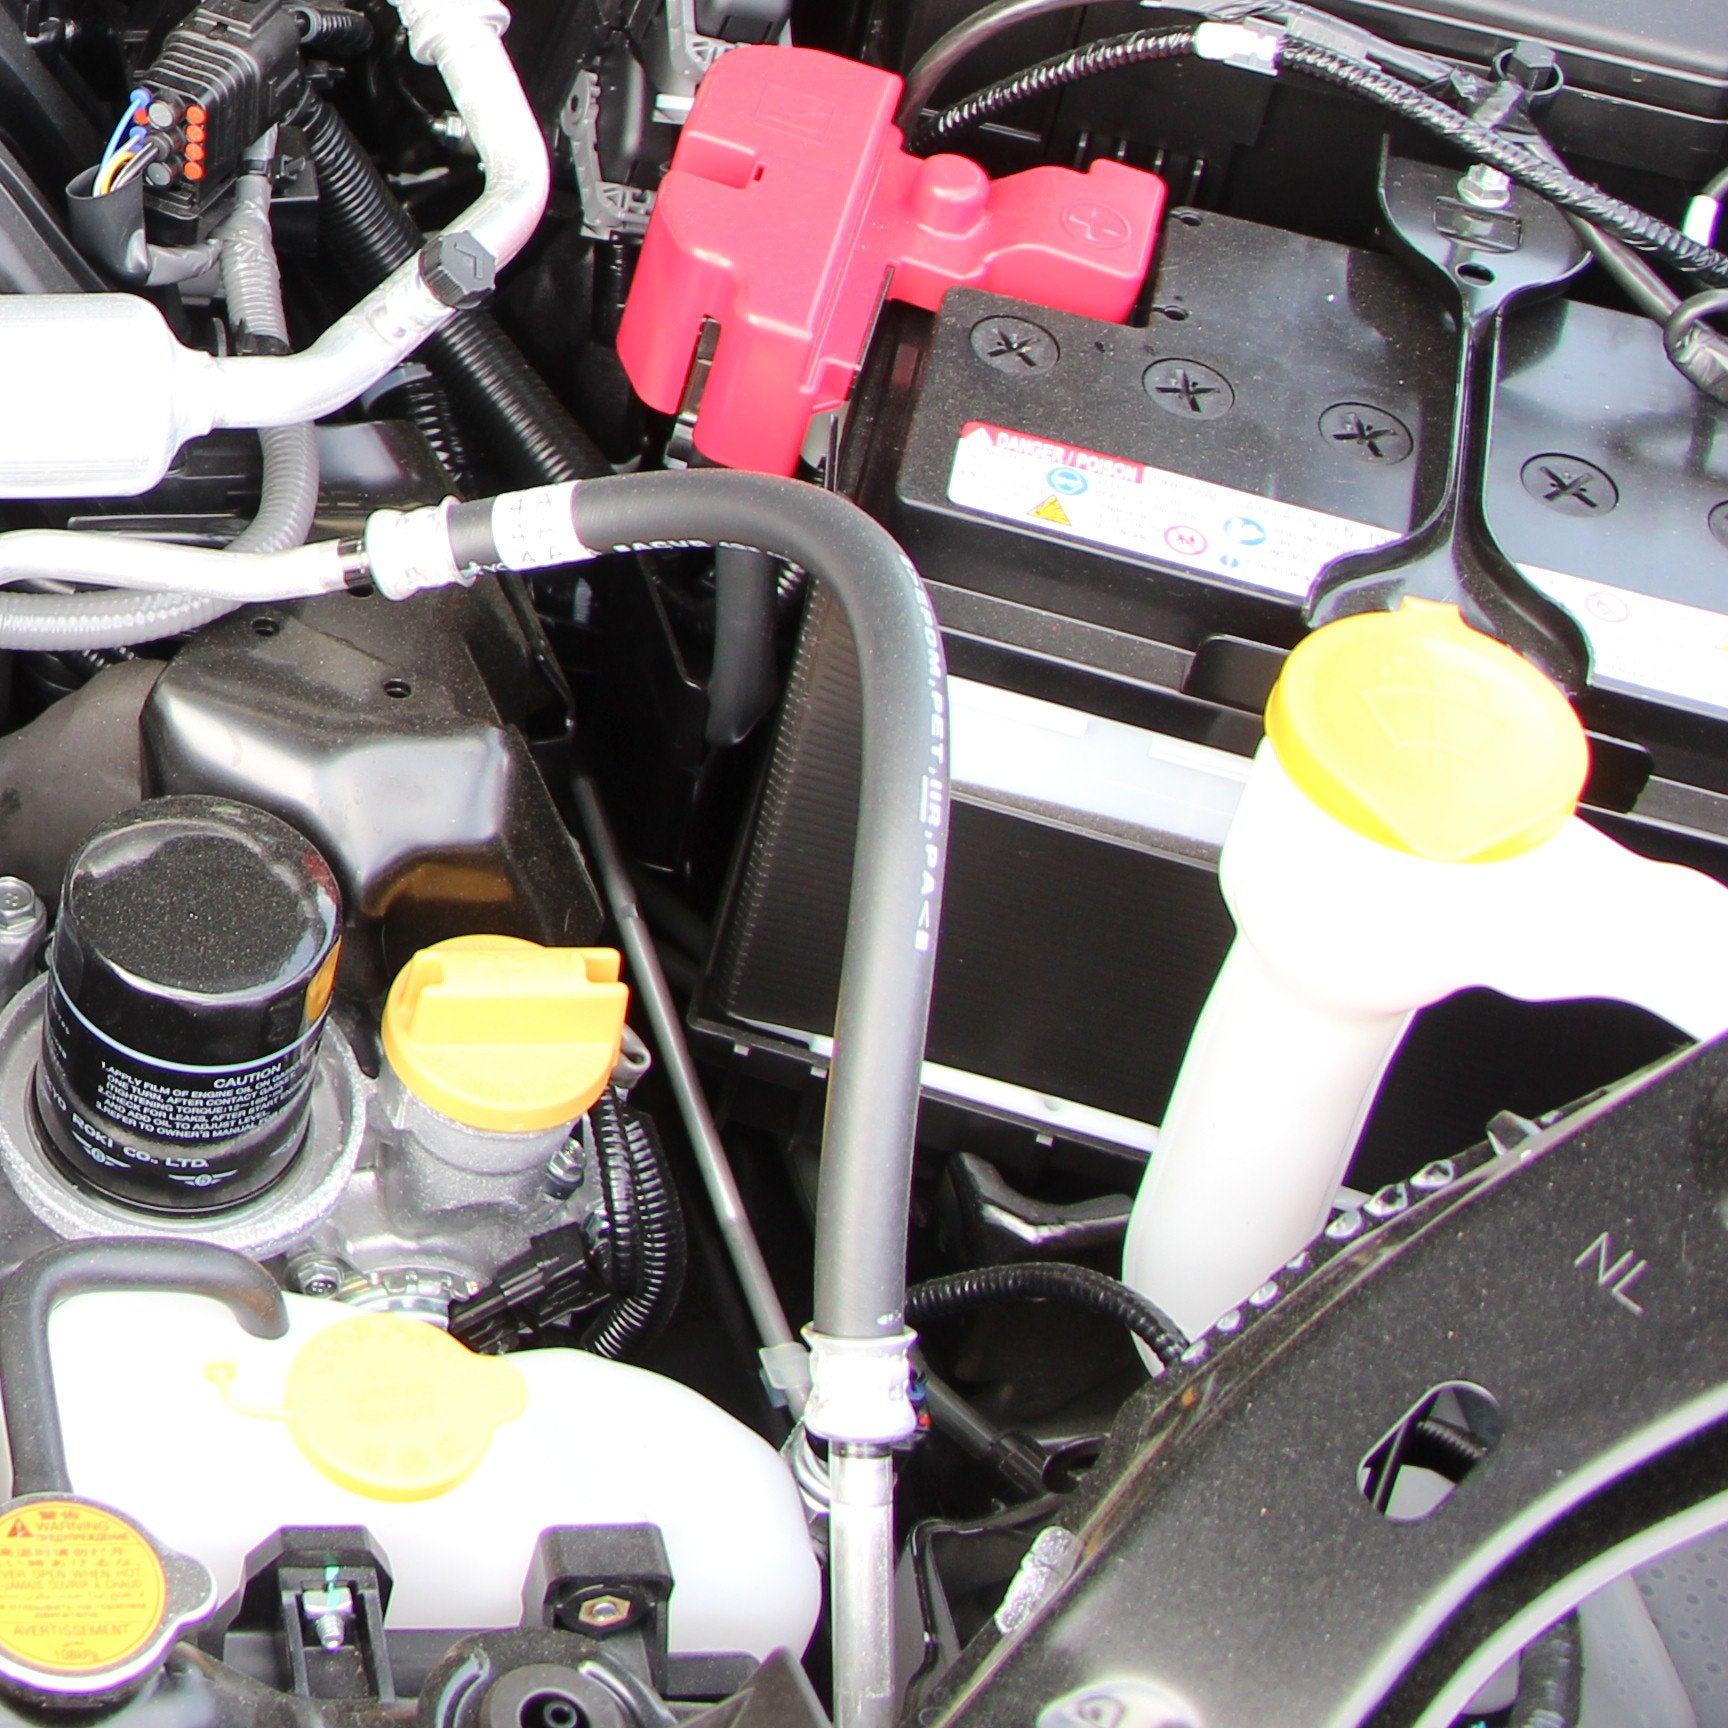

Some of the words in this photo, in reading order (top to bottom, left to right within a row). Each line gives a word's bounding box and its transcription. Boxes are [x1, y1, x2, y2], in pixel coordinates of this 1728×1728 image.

[996, 429, 1066, 466] DANGER
[143, 1081, 171, 1096] FILM
[172, 1088, 190, 1098] OF
[191, 1089, 234, 1099] ENGINE
[213, 1062, 283, 1090] CAUTION
[107, 1074, 130, 1091] ONE
[166, 1096, 204, 1107] AFTER
[205, 1091, 258, 1107] CONTACT
[104, 1099, 127, 1114] AND
[127, 1109, 152, 1124] ADD
[174, 1121, 192, 1130] TO
[192, 1120, 237, 1131] ADJUST
[138, 1121, 156, 1133] TO
[143, 1106, 167, 1119] FOR
[210, 1109, 247, 1122] AFTER
[72, 1112, 114, 1149] ROKI
[36, 1521, 110, 1531] WARNING
